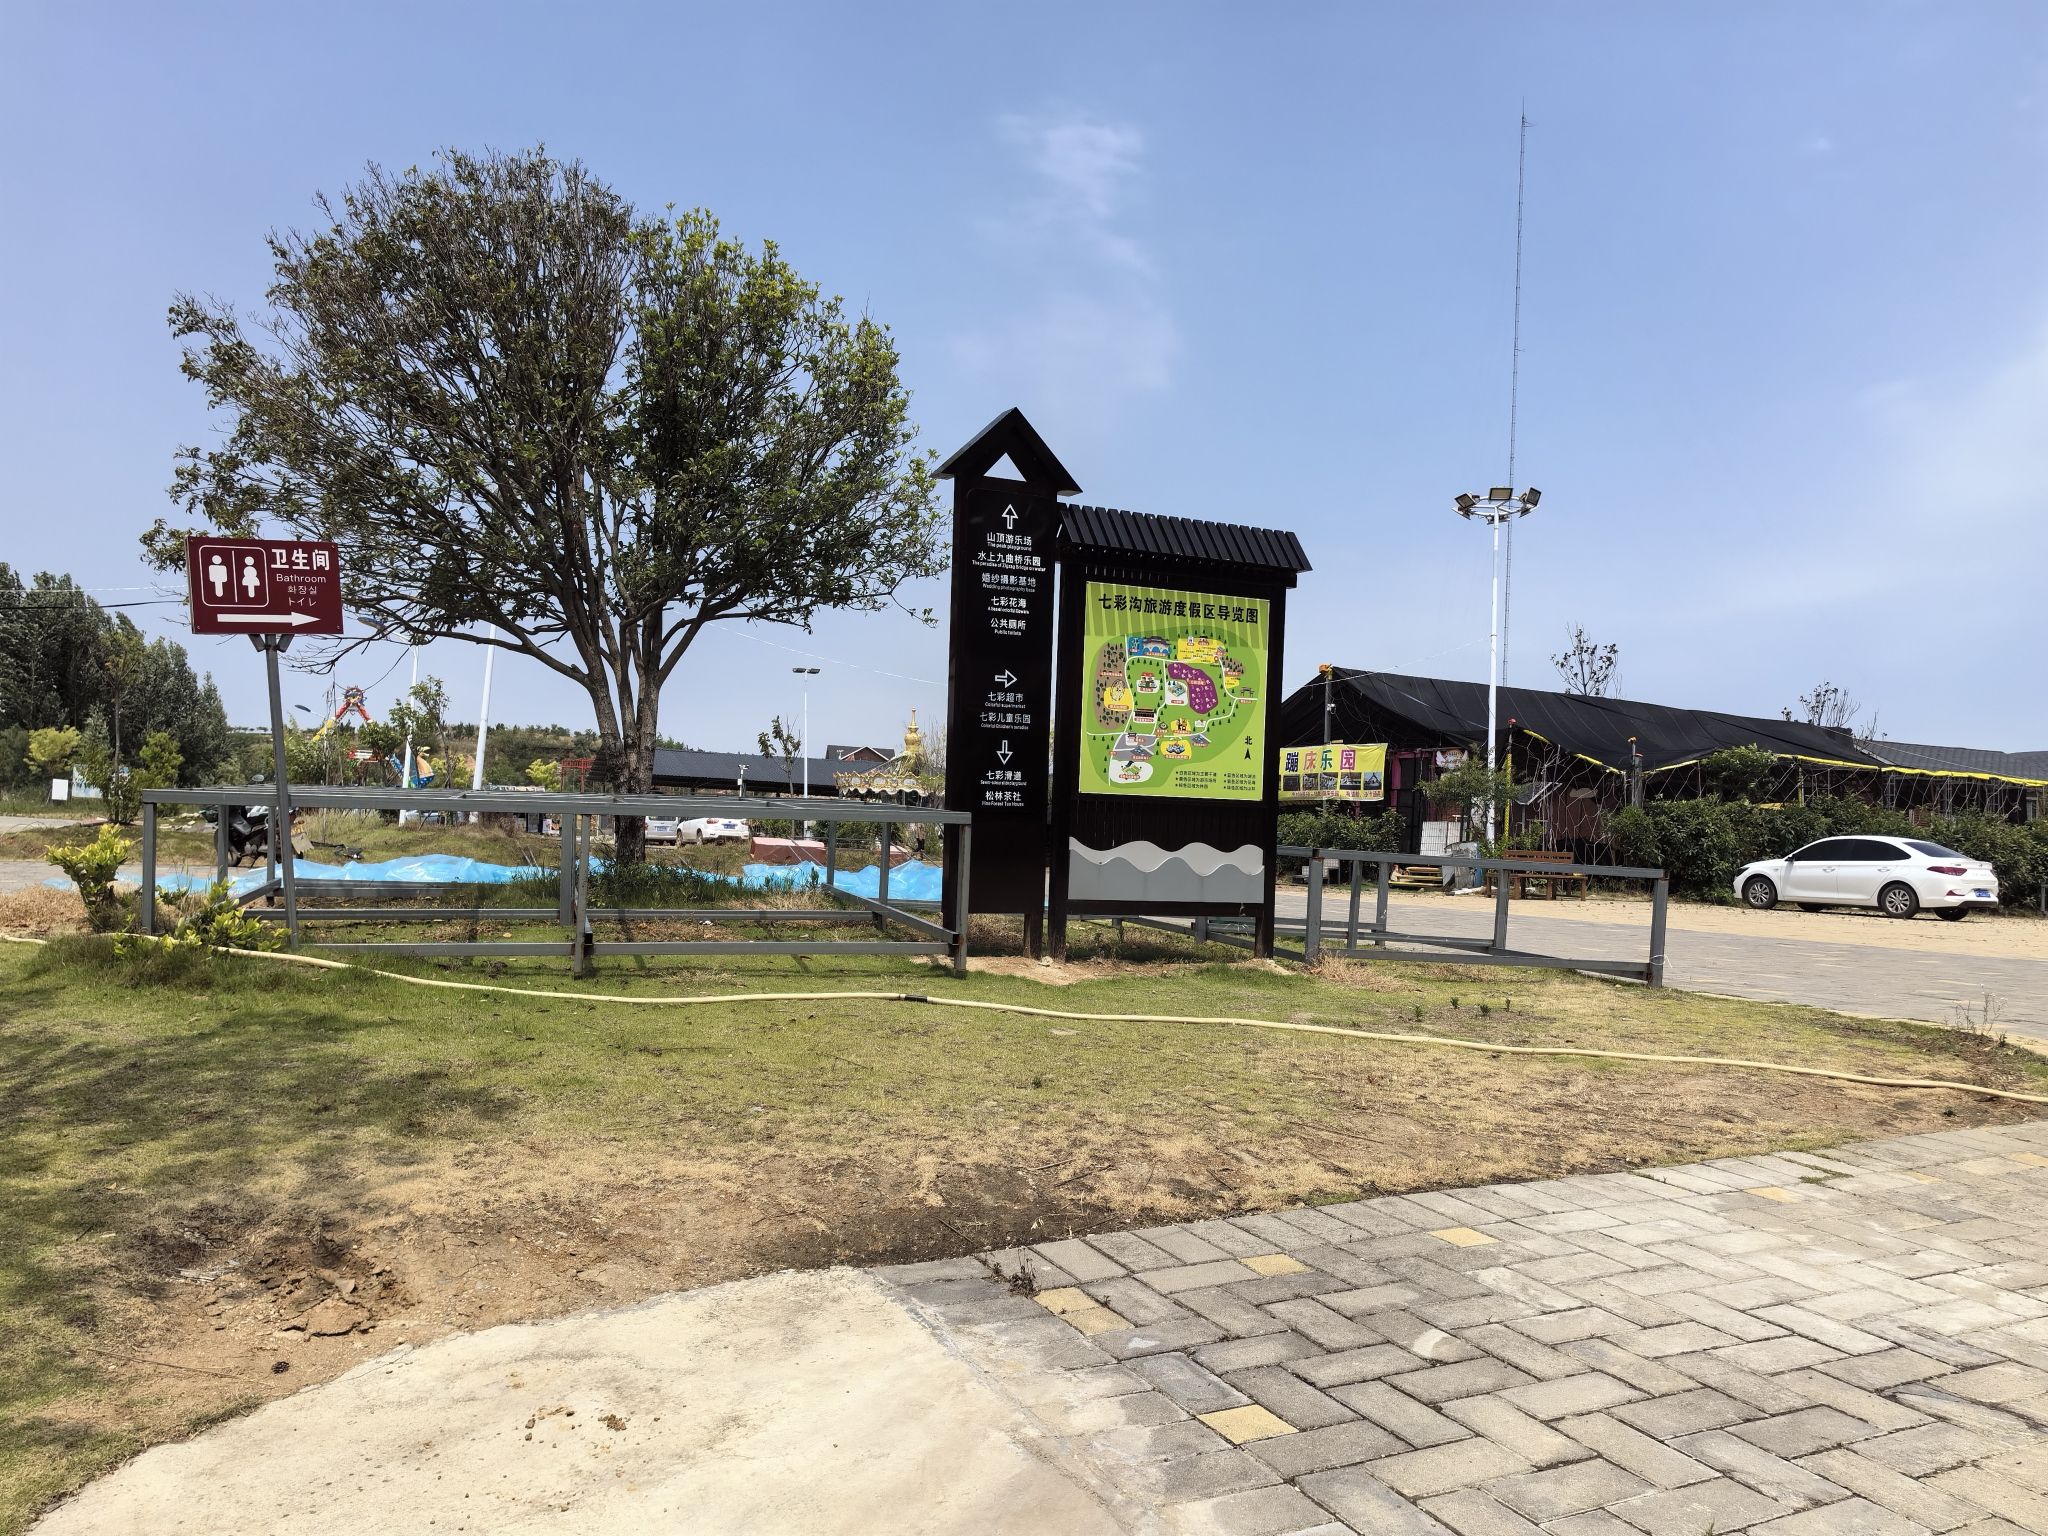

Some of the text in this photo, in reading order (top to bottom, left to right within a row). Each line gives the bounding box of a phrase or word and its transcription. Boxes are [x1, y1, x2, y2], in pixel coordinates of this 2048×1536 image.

[987, 532, 1032, 546] 山顶游乐场
[271, 548, 330, 571] 卫生间
[978, 550, 1041, 566] 水上九曲桥乐园
[276, 573, 327, 583] Bathroom
[288, 585, 317, 595] 화장실
[288, 597, 317, 606] トイレ
[990, 595, 1027, 609] 七彩花海
[1098, 593, 1259, 624] 七彩沟旅游度假区导览图
[988, 691, 1024, 703] 七彩超市
[979, 711, 1031, 724] 七彩儿童乐园
[1244, 735, 1253, 745] 北
[986, 770, 1022, 781] 七彩滑道
[985, 790, 1022, 801] 松林茶社
